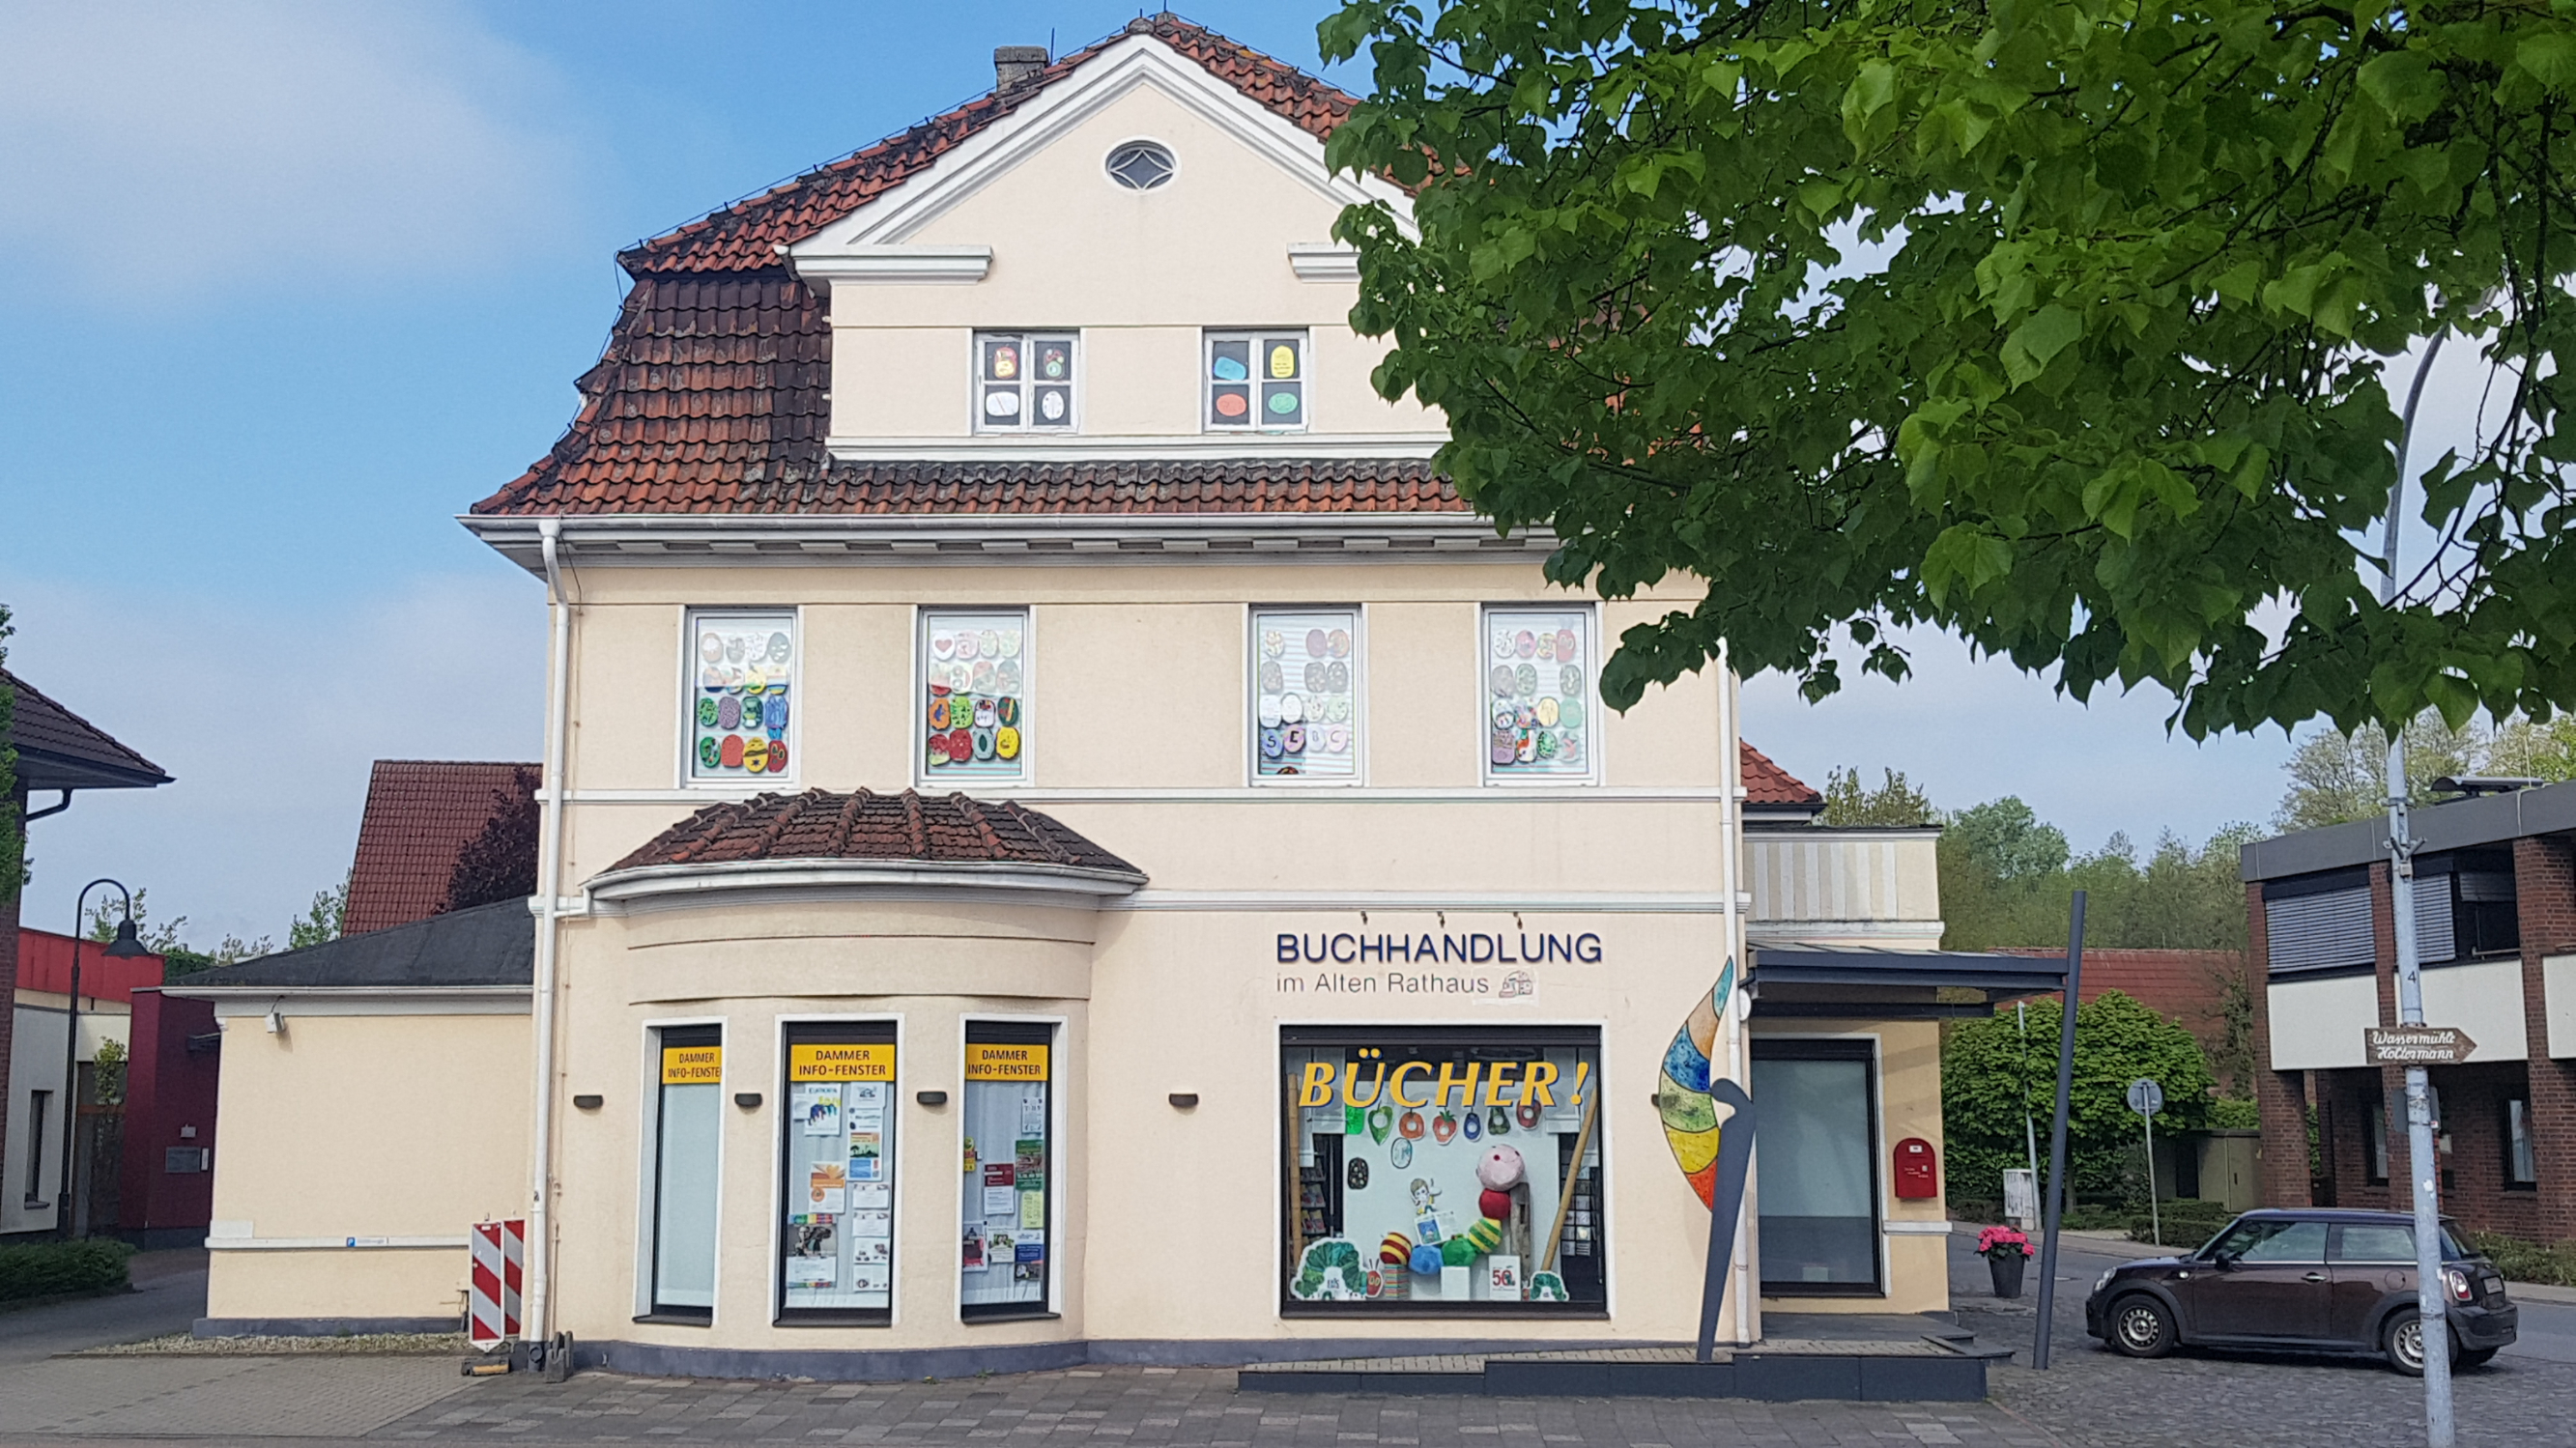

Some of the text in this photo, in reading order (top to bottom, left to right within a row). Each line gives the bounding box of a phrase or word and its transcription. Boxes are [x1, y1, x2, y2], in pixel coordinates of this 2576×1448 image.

[1276, 933, 1602, 964] BUCHHANDLUNG
[1276, 973, 1489, 993] im Alten Rathaus
[2408, 971, 2417, 983] 4
[679, 1053, 715, 1064] DAMMER
[816, 1050, 870, 1061] DAMMER
[982, 1049, 1028, 1061] DAMMER
[668, 1066, 722, 1078] INFO-FENSTE
[799, 1065, 886, 1075] INFO-FENSTER
[967, 1064, 1041, 1075] INFO-FENSTER
